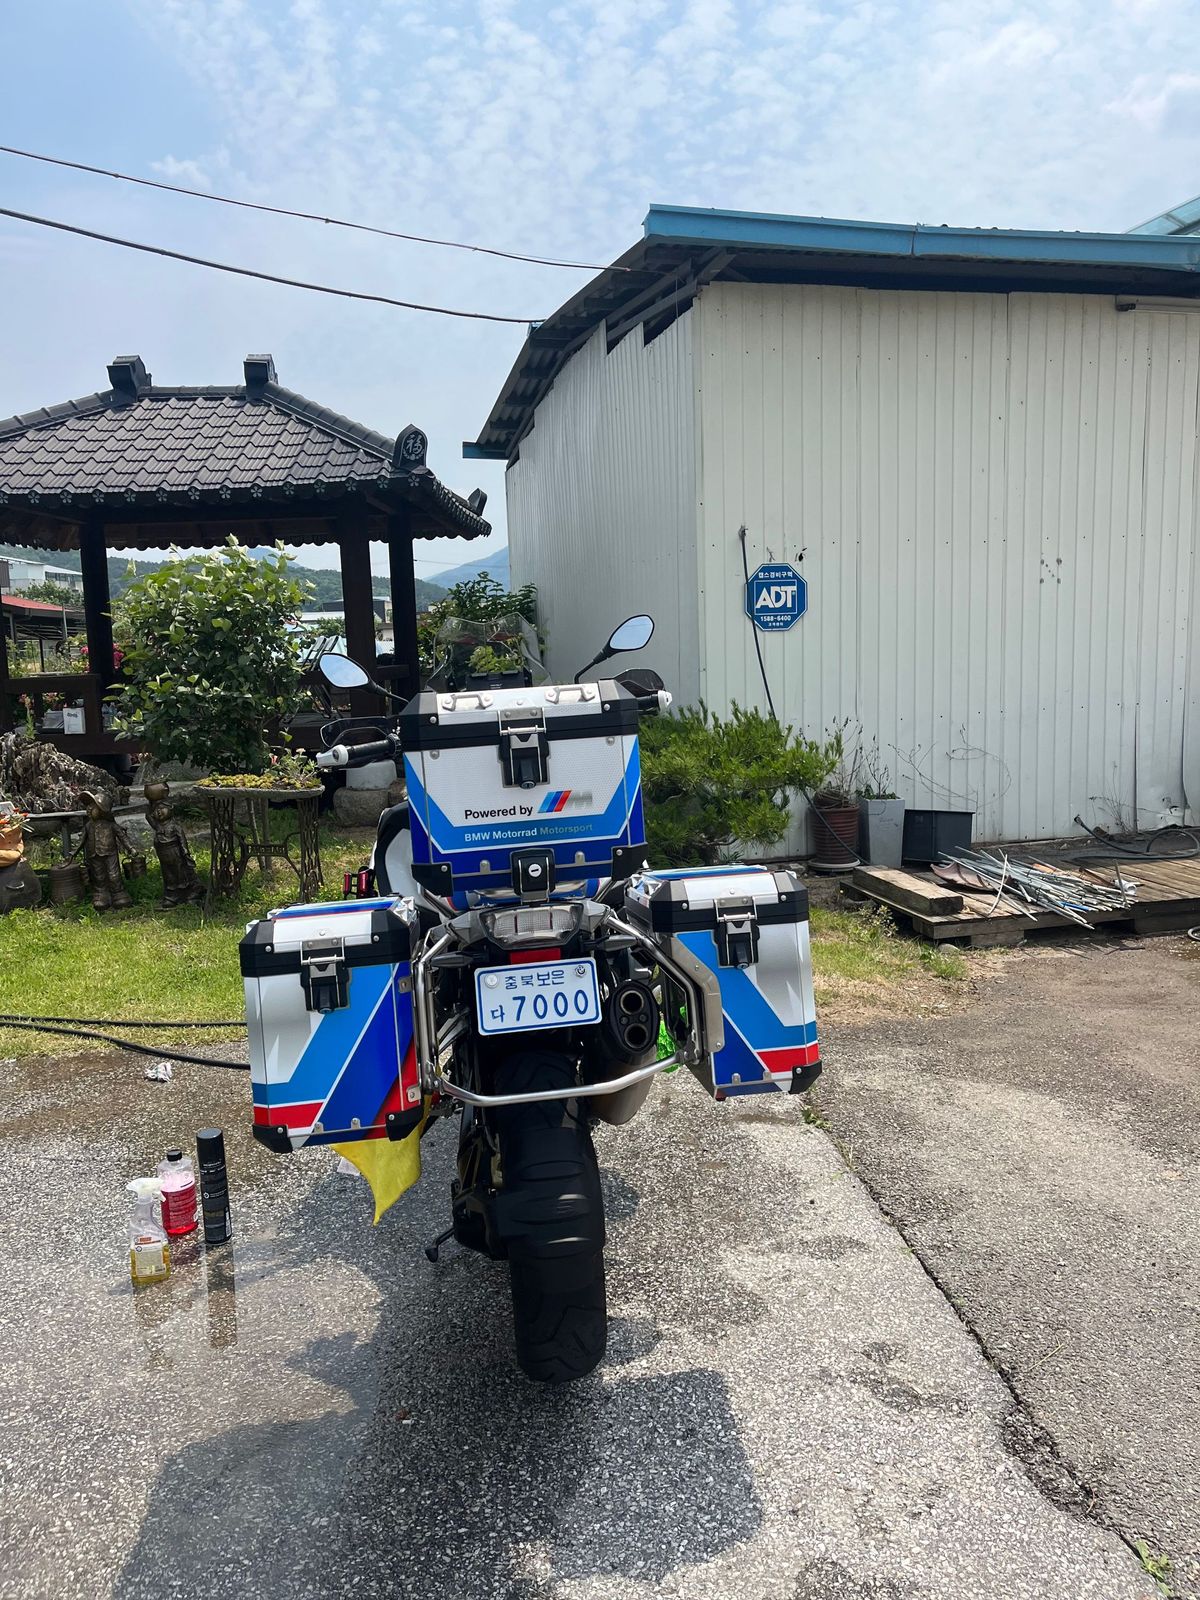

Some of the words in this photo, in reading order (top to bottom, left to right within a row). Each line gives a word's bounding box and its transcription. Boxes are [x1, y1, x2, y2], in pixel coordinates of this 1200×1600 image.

[755, 585, 797, 608] ADT
[464, 805, 516, 820] Powered
[519, 804, 533, 817] by
[464, 831, 490, 842] BMW
[492, 828, 538, 839] Motorrad
[539, 823, 593, 836] Motorsport
[490, 1004, 505, 1023] 다
[512, 989, 589, 1022] 7000
